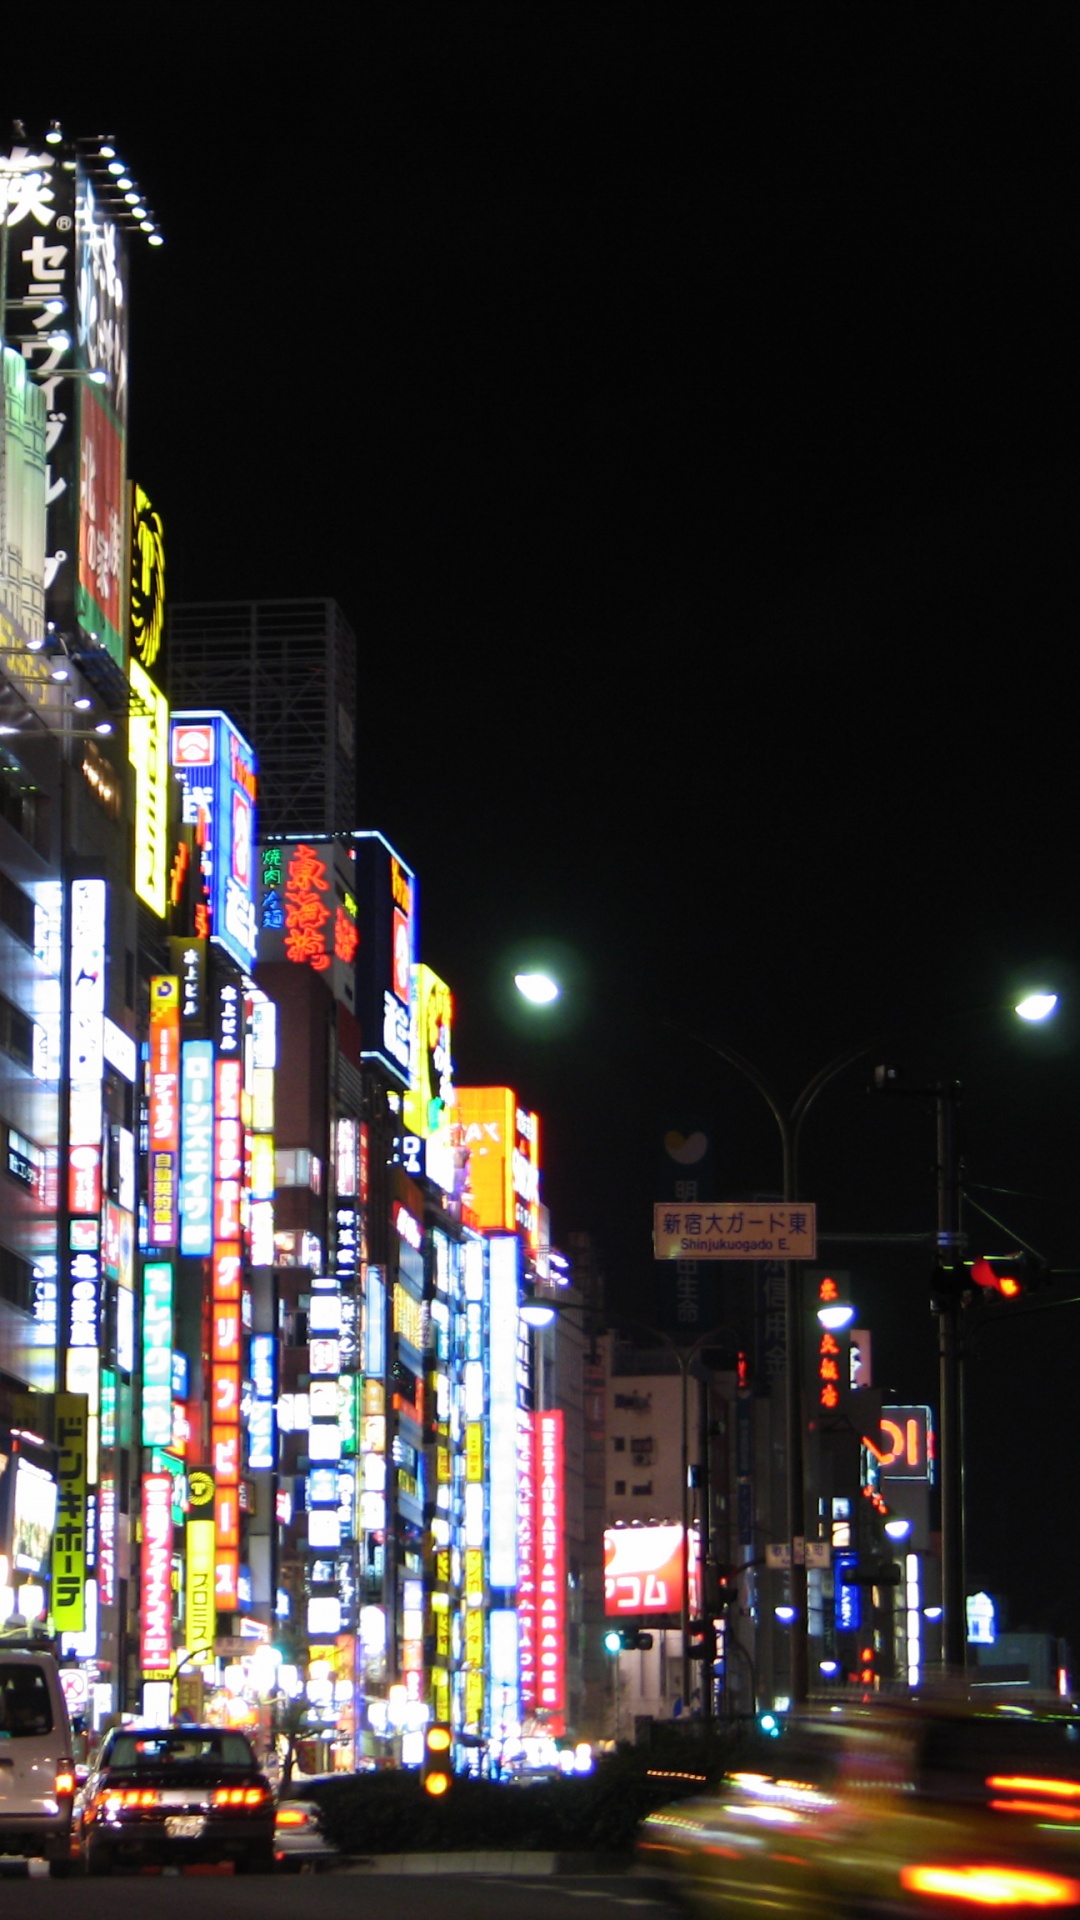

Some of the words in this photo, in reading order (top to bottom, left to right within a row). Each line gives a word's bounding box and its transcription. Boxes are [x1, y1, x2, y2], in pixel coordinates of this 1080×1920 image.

[154, 1074, 176, 1139] ディック
[185, 1057, 209, 1220] ローンズエイワ
[663, 1212, 807, 1235] 新宿大ガード東
[675, 1180, 698, 1322] 明田生命
[681, 1238, 773, 1252] Shinjukuogado
[778, 1239, 790, 1250] E.
[57, 1417, 82, 1607] ドン・キホーテ
[540, 1418, 556, 1560] RESTAURANT
[193, 1573, 208, 1640] プロミス
[540, 1580, 557, 1702] KARAOKE
